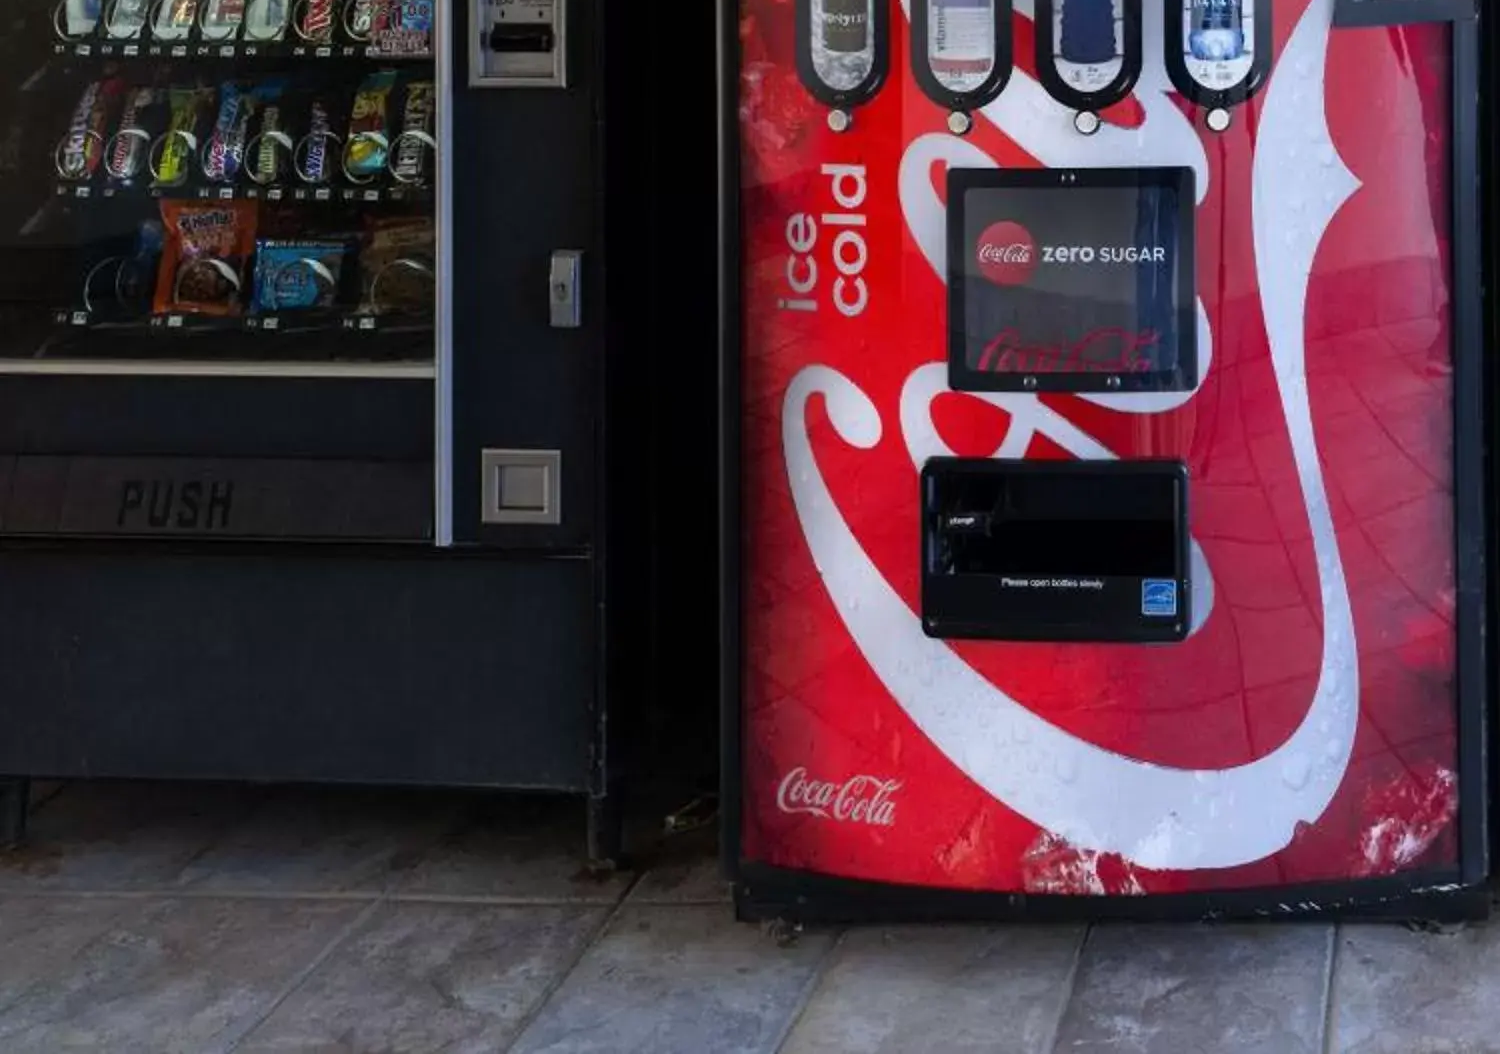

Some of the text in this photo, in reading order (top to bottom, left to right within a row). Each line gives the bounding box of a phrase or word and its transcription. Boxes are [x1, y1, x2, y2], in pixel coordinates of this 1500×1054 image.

[777, 213, 818, 312] ice
[821, 163, 868, 317] cold
[978, 242, 1166, 265] Coca-Cola zero SUGAR
[117, 479, 234, 528] PUSH
[1001, 577, 1028, 587] Please
[1030, 579, 1050, 591] open
[1051, 579, 1078, 588] bottles
[776, 766, 905, 826] Coca-Cola
